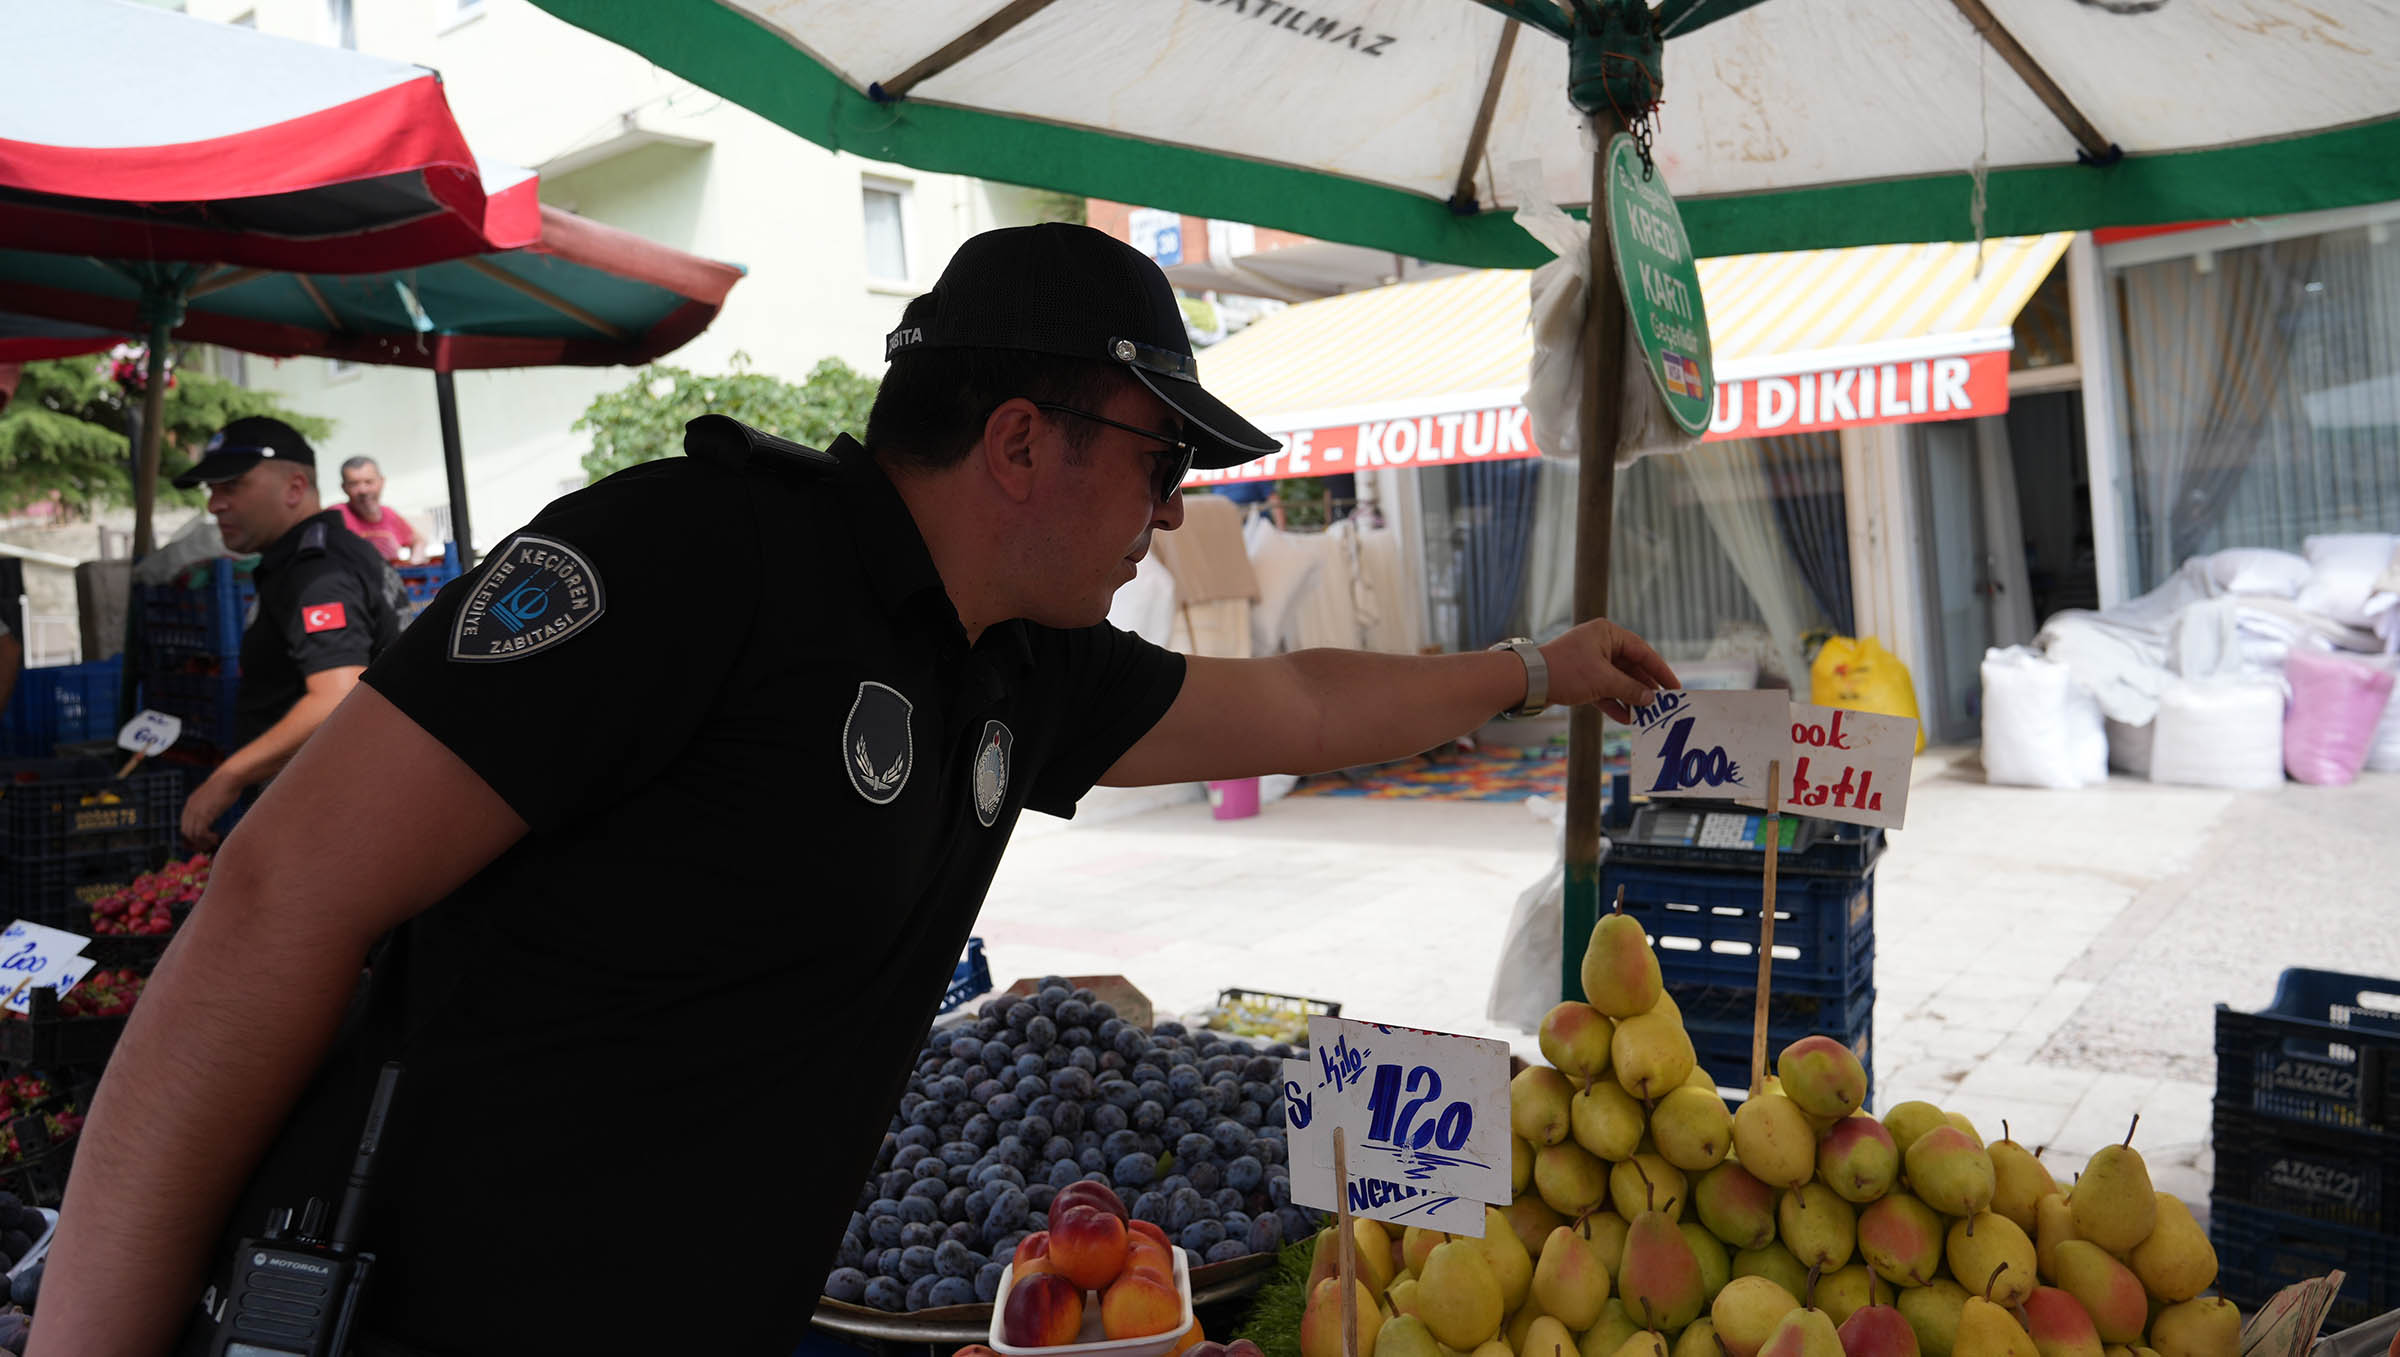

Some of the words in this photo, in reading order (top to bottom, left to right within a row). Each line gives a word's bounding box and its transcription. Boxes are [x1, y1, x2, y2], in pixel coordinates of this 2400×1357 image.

[1196, 0, 1398, 57] ATILMAZ
[1638, 259, 1694, 321] KARTI
[1355, 405, 1530, 468] KOLTUK
[462, 560, 517, 636] BELEDİYE
[519, 548, 590, 611] KEÇİÖREN
[489, 612, 575, 655] ZABITASI
[1787, 756, 1882, 812] tatlı
[1366, 1064, 1474, 1152] 120
[268, 1257, 329, 1275] MOTOROLA
